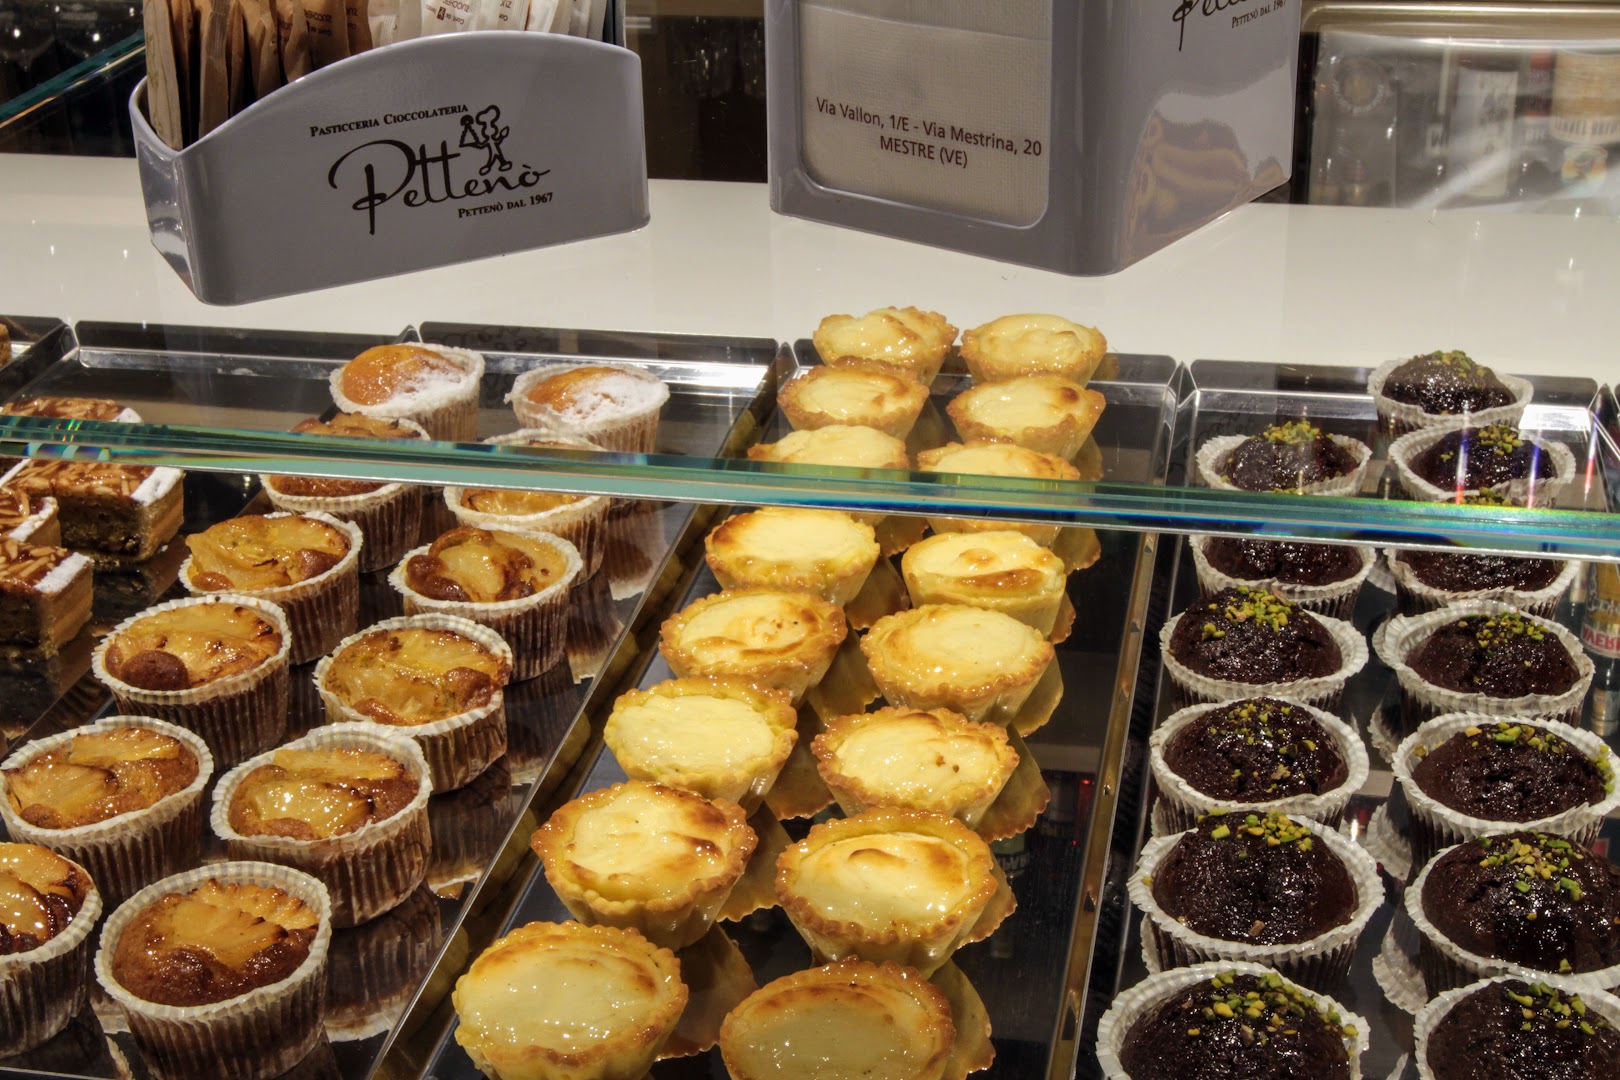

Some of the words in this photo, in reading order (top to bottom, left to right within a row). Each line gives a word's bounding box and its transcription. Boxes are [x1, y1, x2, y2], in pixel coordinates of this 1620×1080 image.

[310, 118, 380, 137] PASTICCERIA
[384, 104, 469, 125] CIOCCOLATERIA
[816, 97, 836, 115] Via
[839, 103, 884, 129] Vallon,
[889, 115, 910, 132] 1/E
[923, 120, 946, 138] Via
[950, 125, 1018, 155] Mestrina,
[1023, 139, 1042, 157] 20
[880, 135, 935, 160] MESTRE
[939, 147, 968, 169] (VE)
[458, 201, 503, 219] PETTENÒ
[507, 199, 527, 210] DAL
[529, 192, 553, 207] 1967
